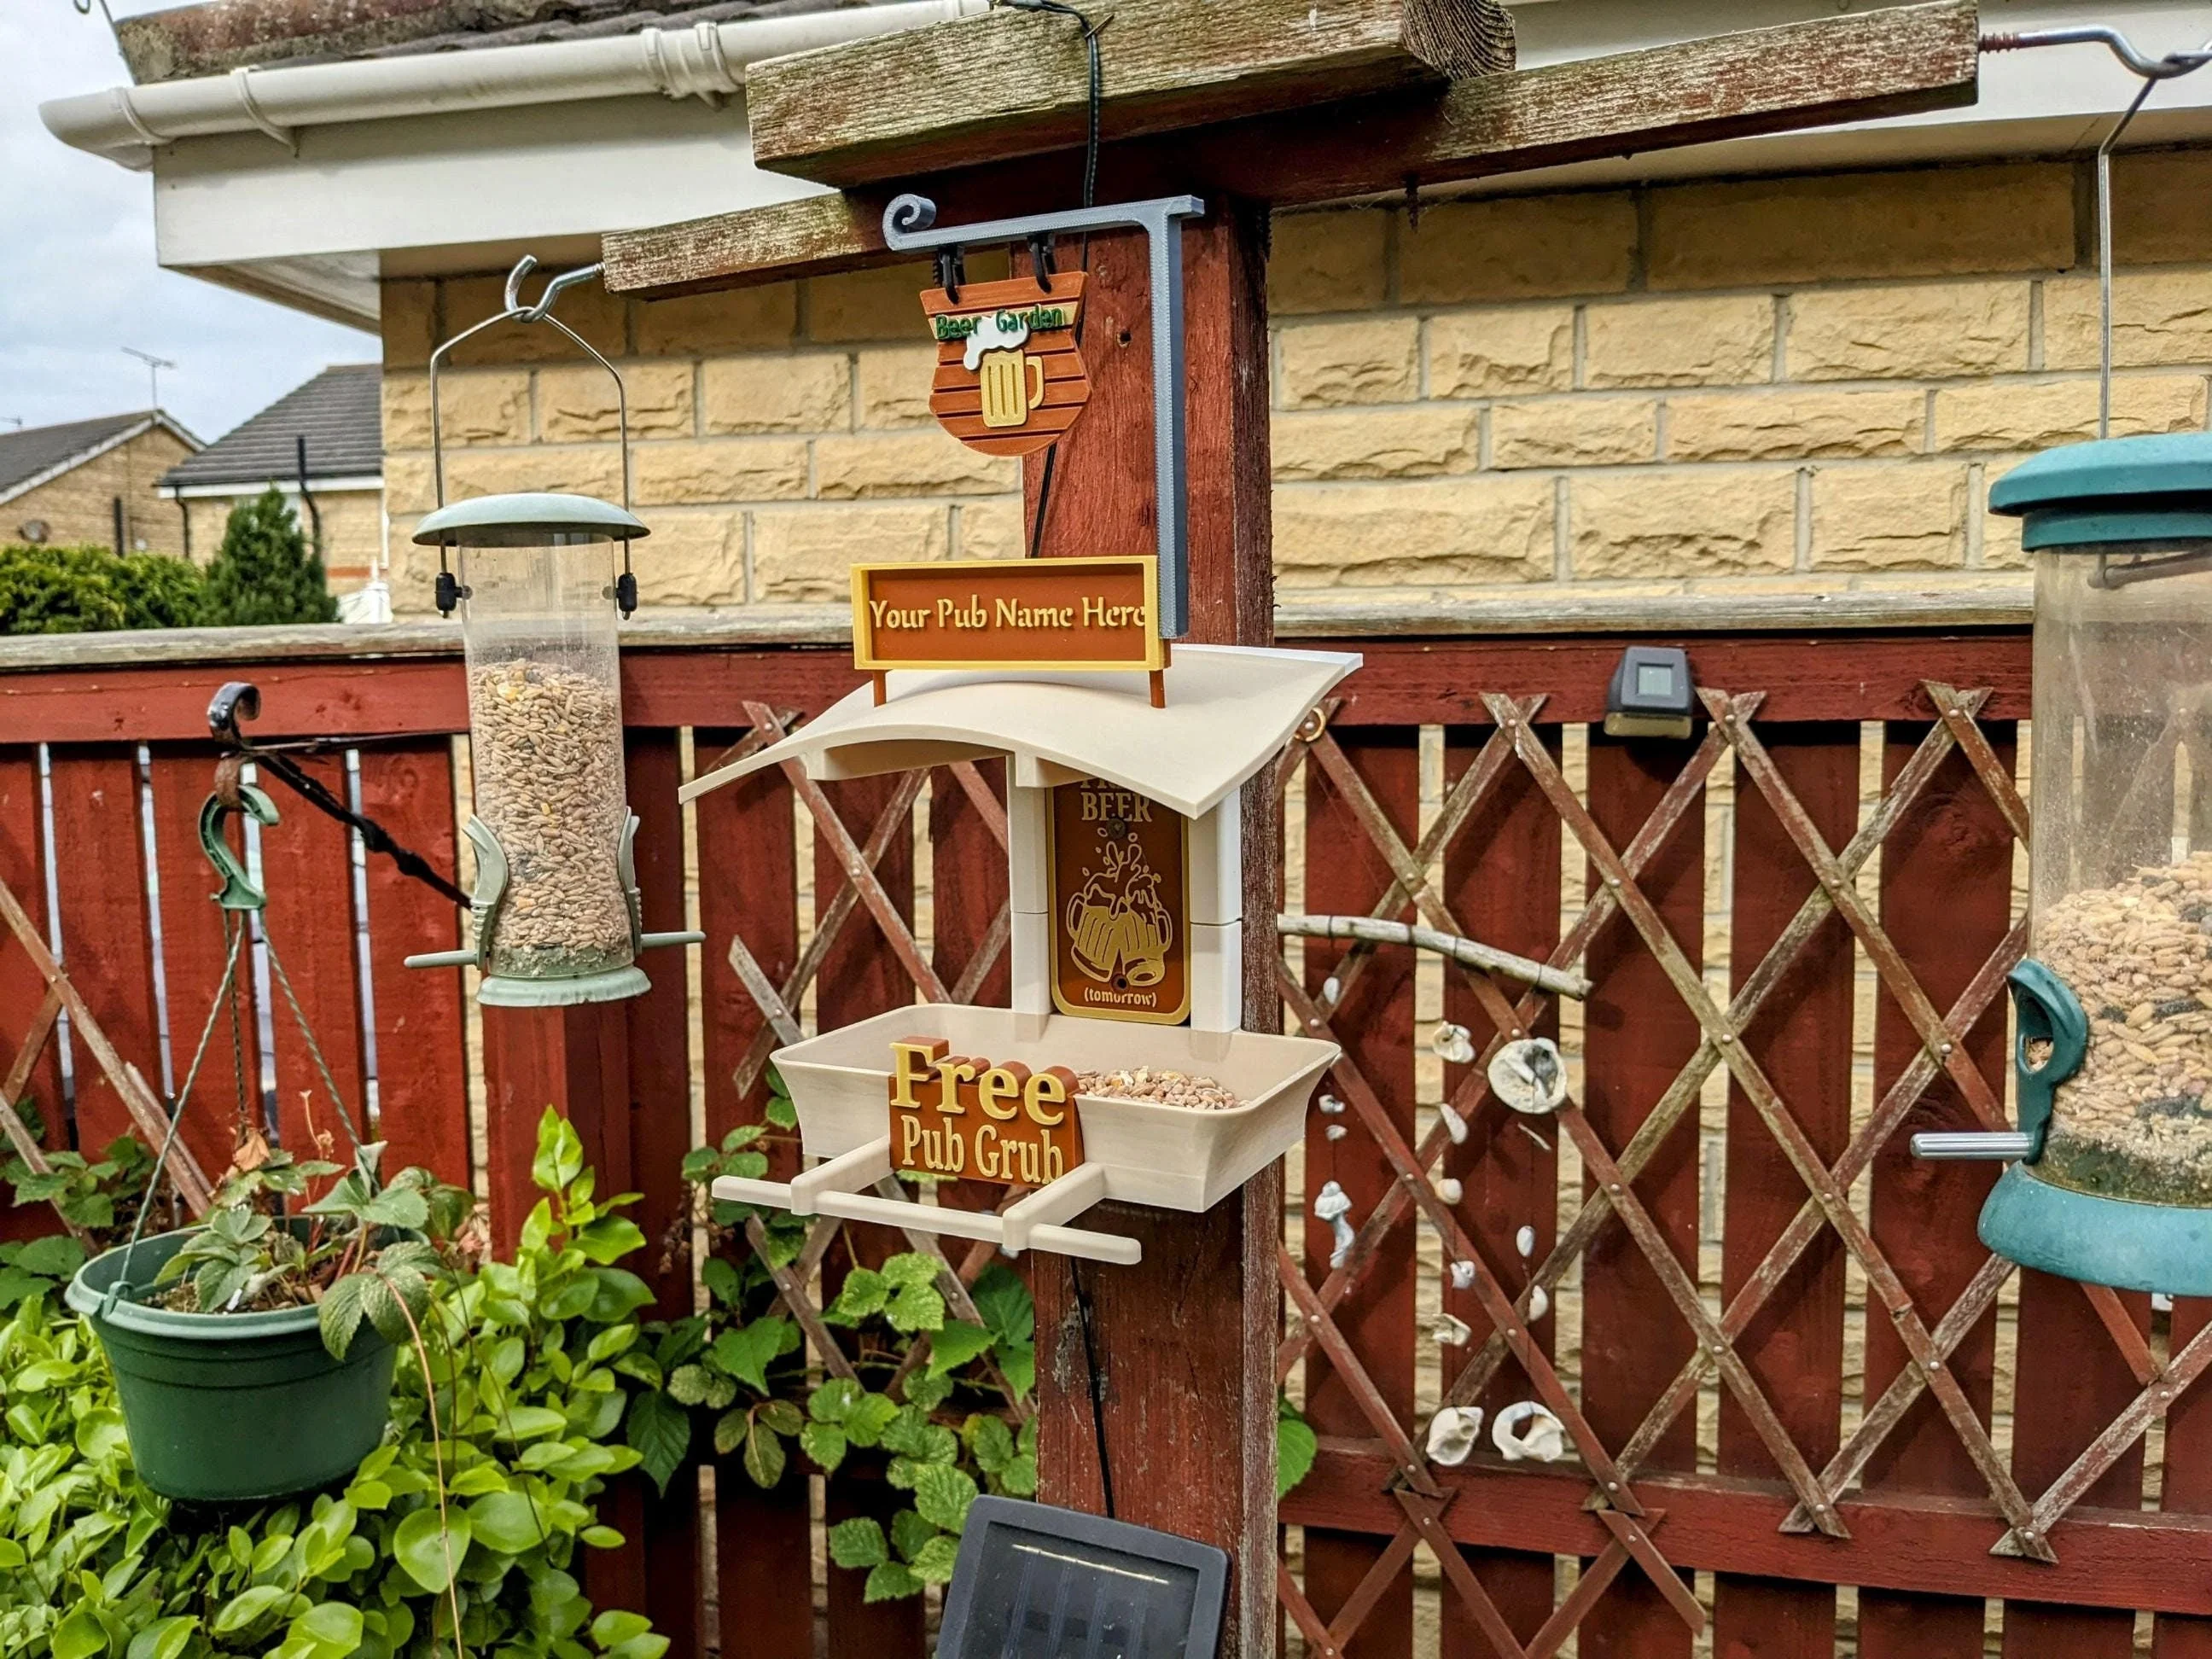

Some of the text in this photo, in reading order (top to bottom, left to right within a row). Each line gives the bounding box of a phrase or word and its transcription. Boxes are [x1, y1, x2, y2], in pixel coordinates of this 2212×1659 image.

[934, 303, 1065, 338] Beer Garden
[869, 594, 1144, 629] Your Pub Name Here
[1080, 791, 1153, 823] BEER
[1084, 987, 1157, 1008] (tomorrow)
[889, 1040, 1067, 1126] Free
[900, 1114, 1063, 1185] Pub Grub
